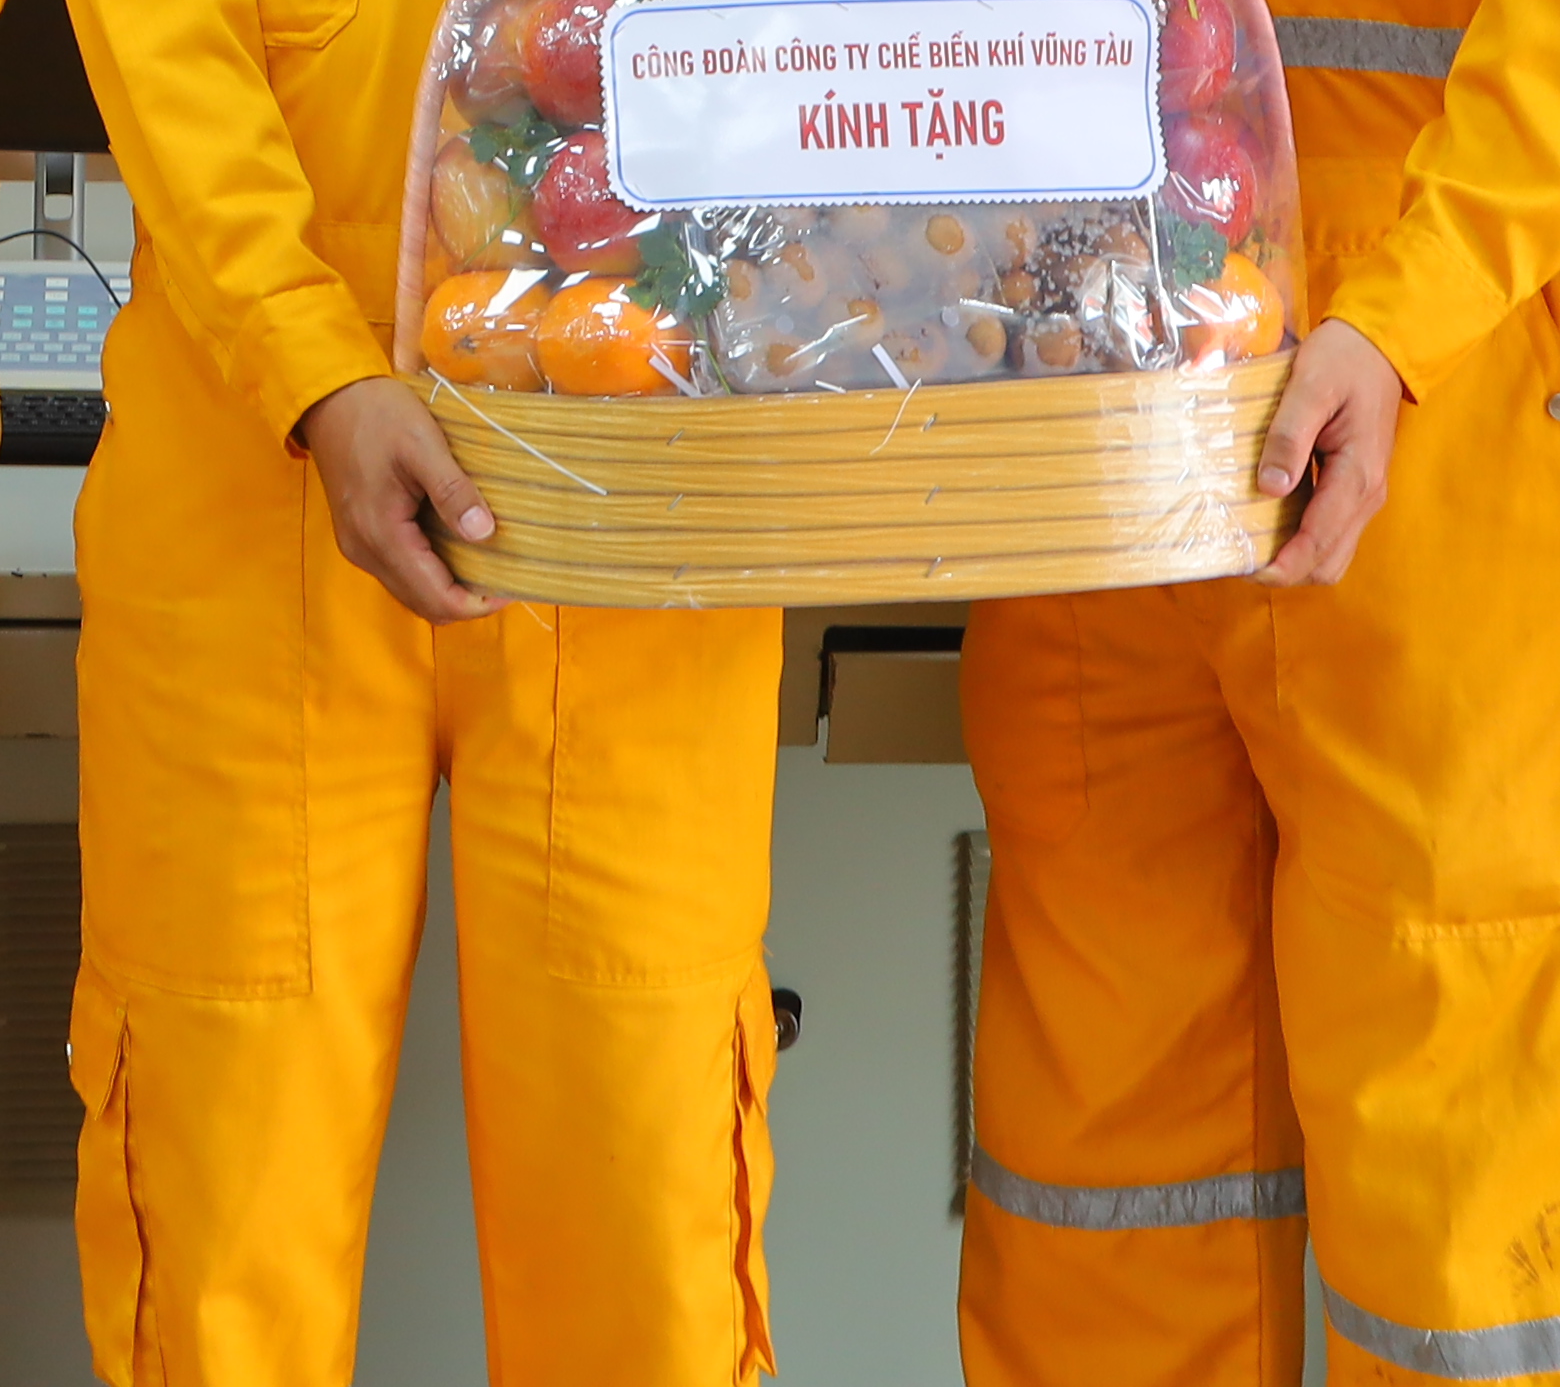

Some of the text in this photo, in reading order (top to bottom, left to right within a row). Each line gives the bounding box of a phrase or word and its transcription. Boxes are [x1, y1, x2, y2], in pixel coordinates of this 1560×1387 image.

[632, 30, 1133, 80] CÔNG ĐOÀN CÔNG TY CHẾ BIẾN KHÍ VŨNG TÀU
[798, 88, 1007, 161] KÍNH TẶNG
